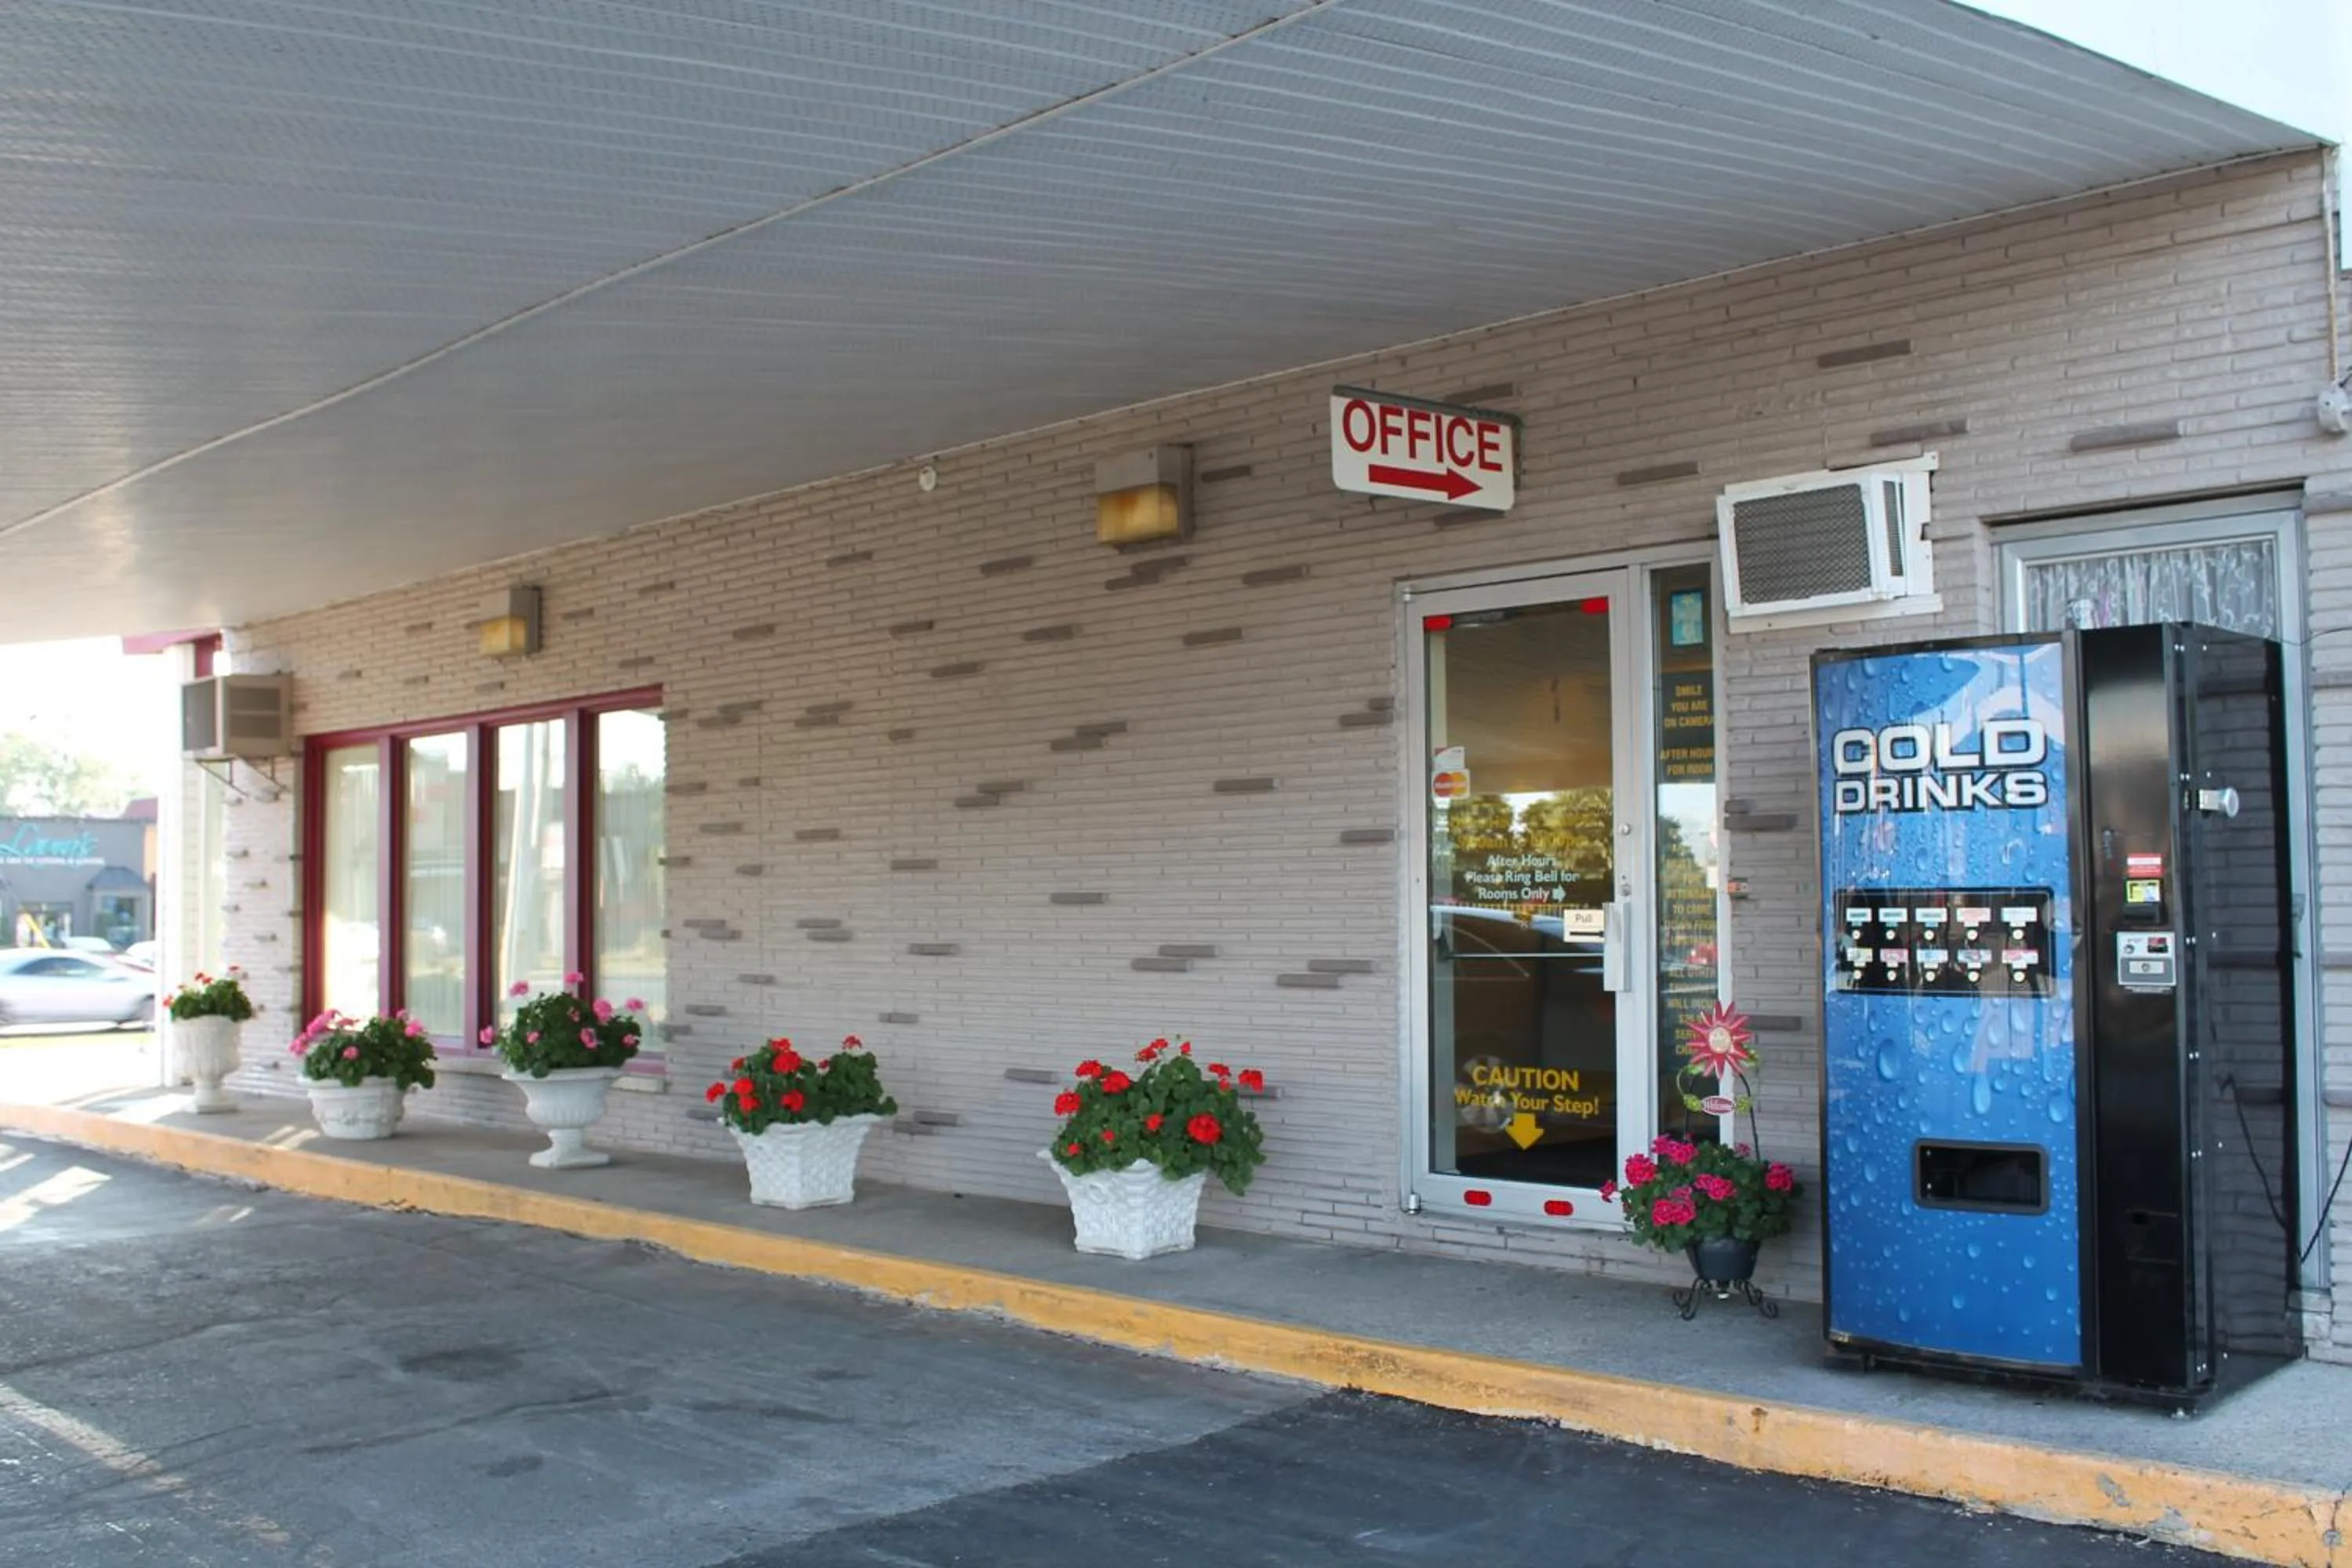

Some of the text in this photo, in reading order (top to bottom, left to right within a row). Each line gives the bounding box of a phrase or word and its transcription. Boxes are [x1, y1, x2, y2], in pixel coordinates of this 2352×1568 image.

[1342, 398, 1504, 472] OFFICE
[1671, 700, 1707, 712] YOU ARE
[1664, 717, 1677, 728] ON
[1660, 748, 1688, 760] AFTER
[1833, 719, 2047, 775] COLD
[1667, 764, 1685, 775] FOR
[1835, 771, 2049, 814] DRINKS
[1486, 855, 1519, 868] After
[1465, 869, 1581, 886] Please Ring Bell for
[1477, 887, 1551, 902] Rooms Only
[1575, 913, 1593, 924] Pull
[1472, 1065, 1580, 1092] CAUTION
[1454, 1087, 1600, 1120] Watch Your Step!
